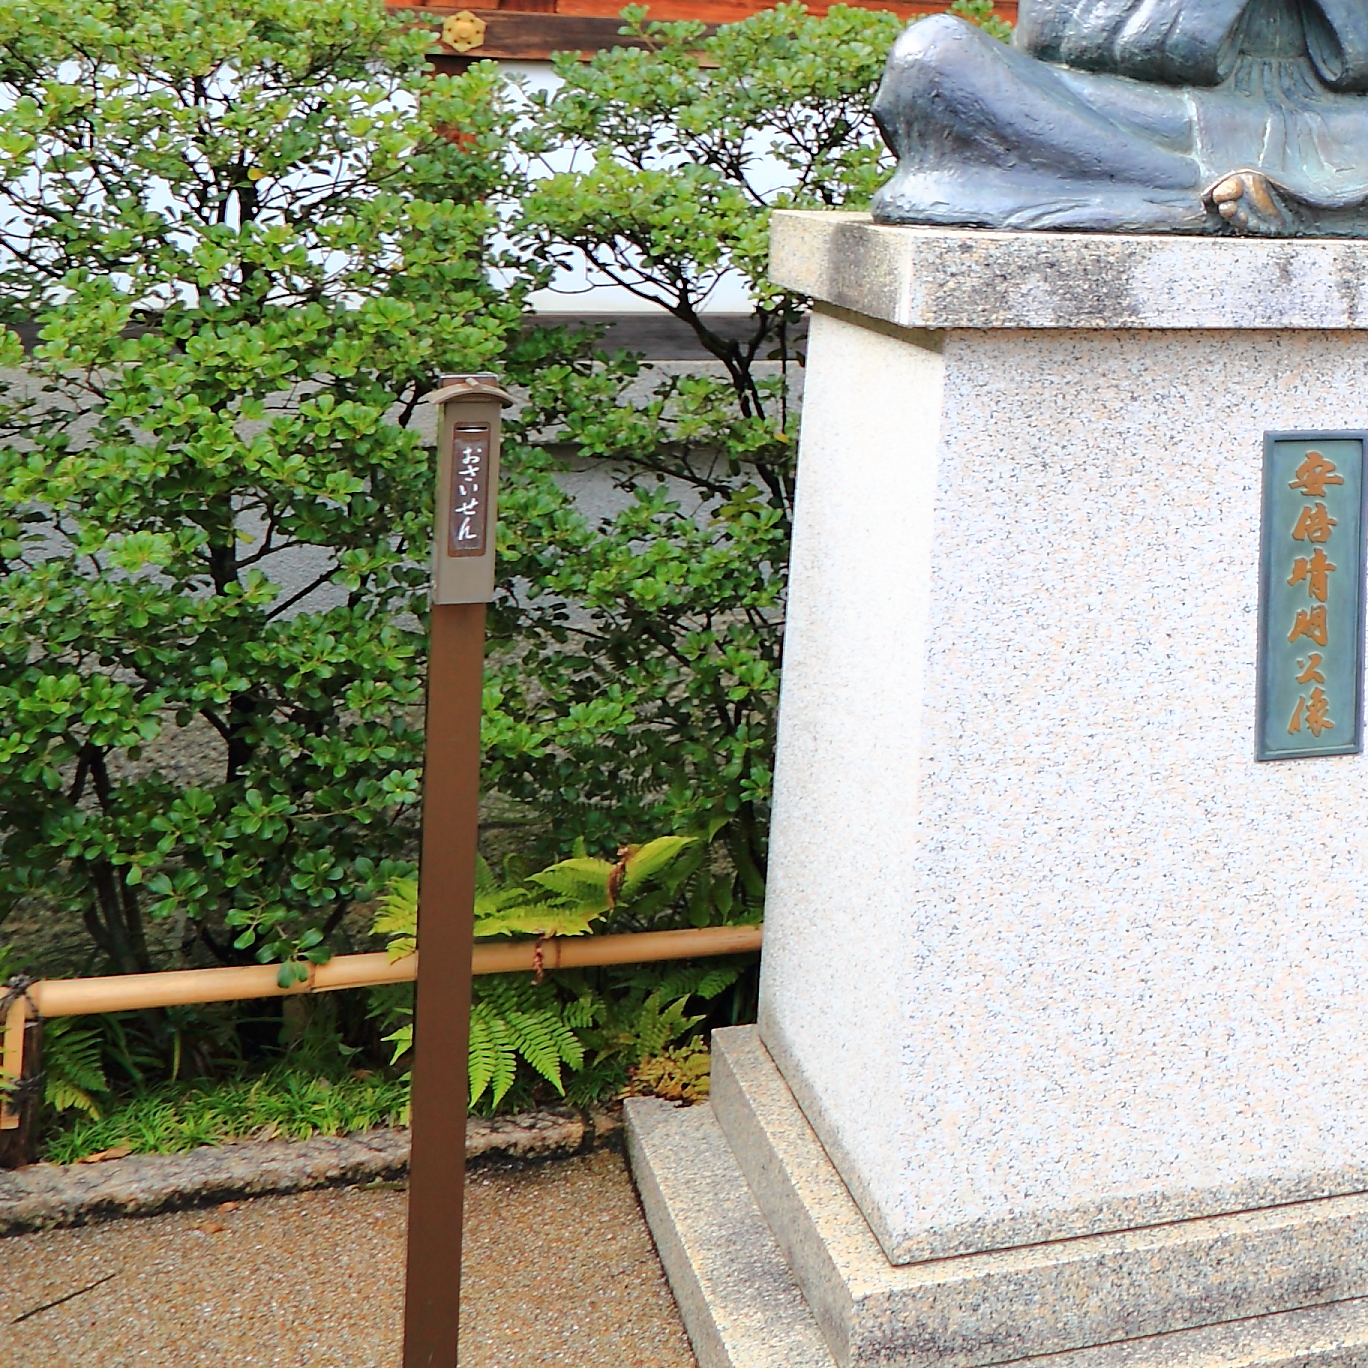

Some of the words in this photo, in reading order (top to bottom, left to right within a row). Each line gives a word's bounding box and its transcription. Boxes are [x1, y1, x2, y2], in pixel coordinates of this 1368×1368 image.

[454, 447, 482, 541] おさいせん
[1287, 451, 1344, 738] 安倍晴明公像
